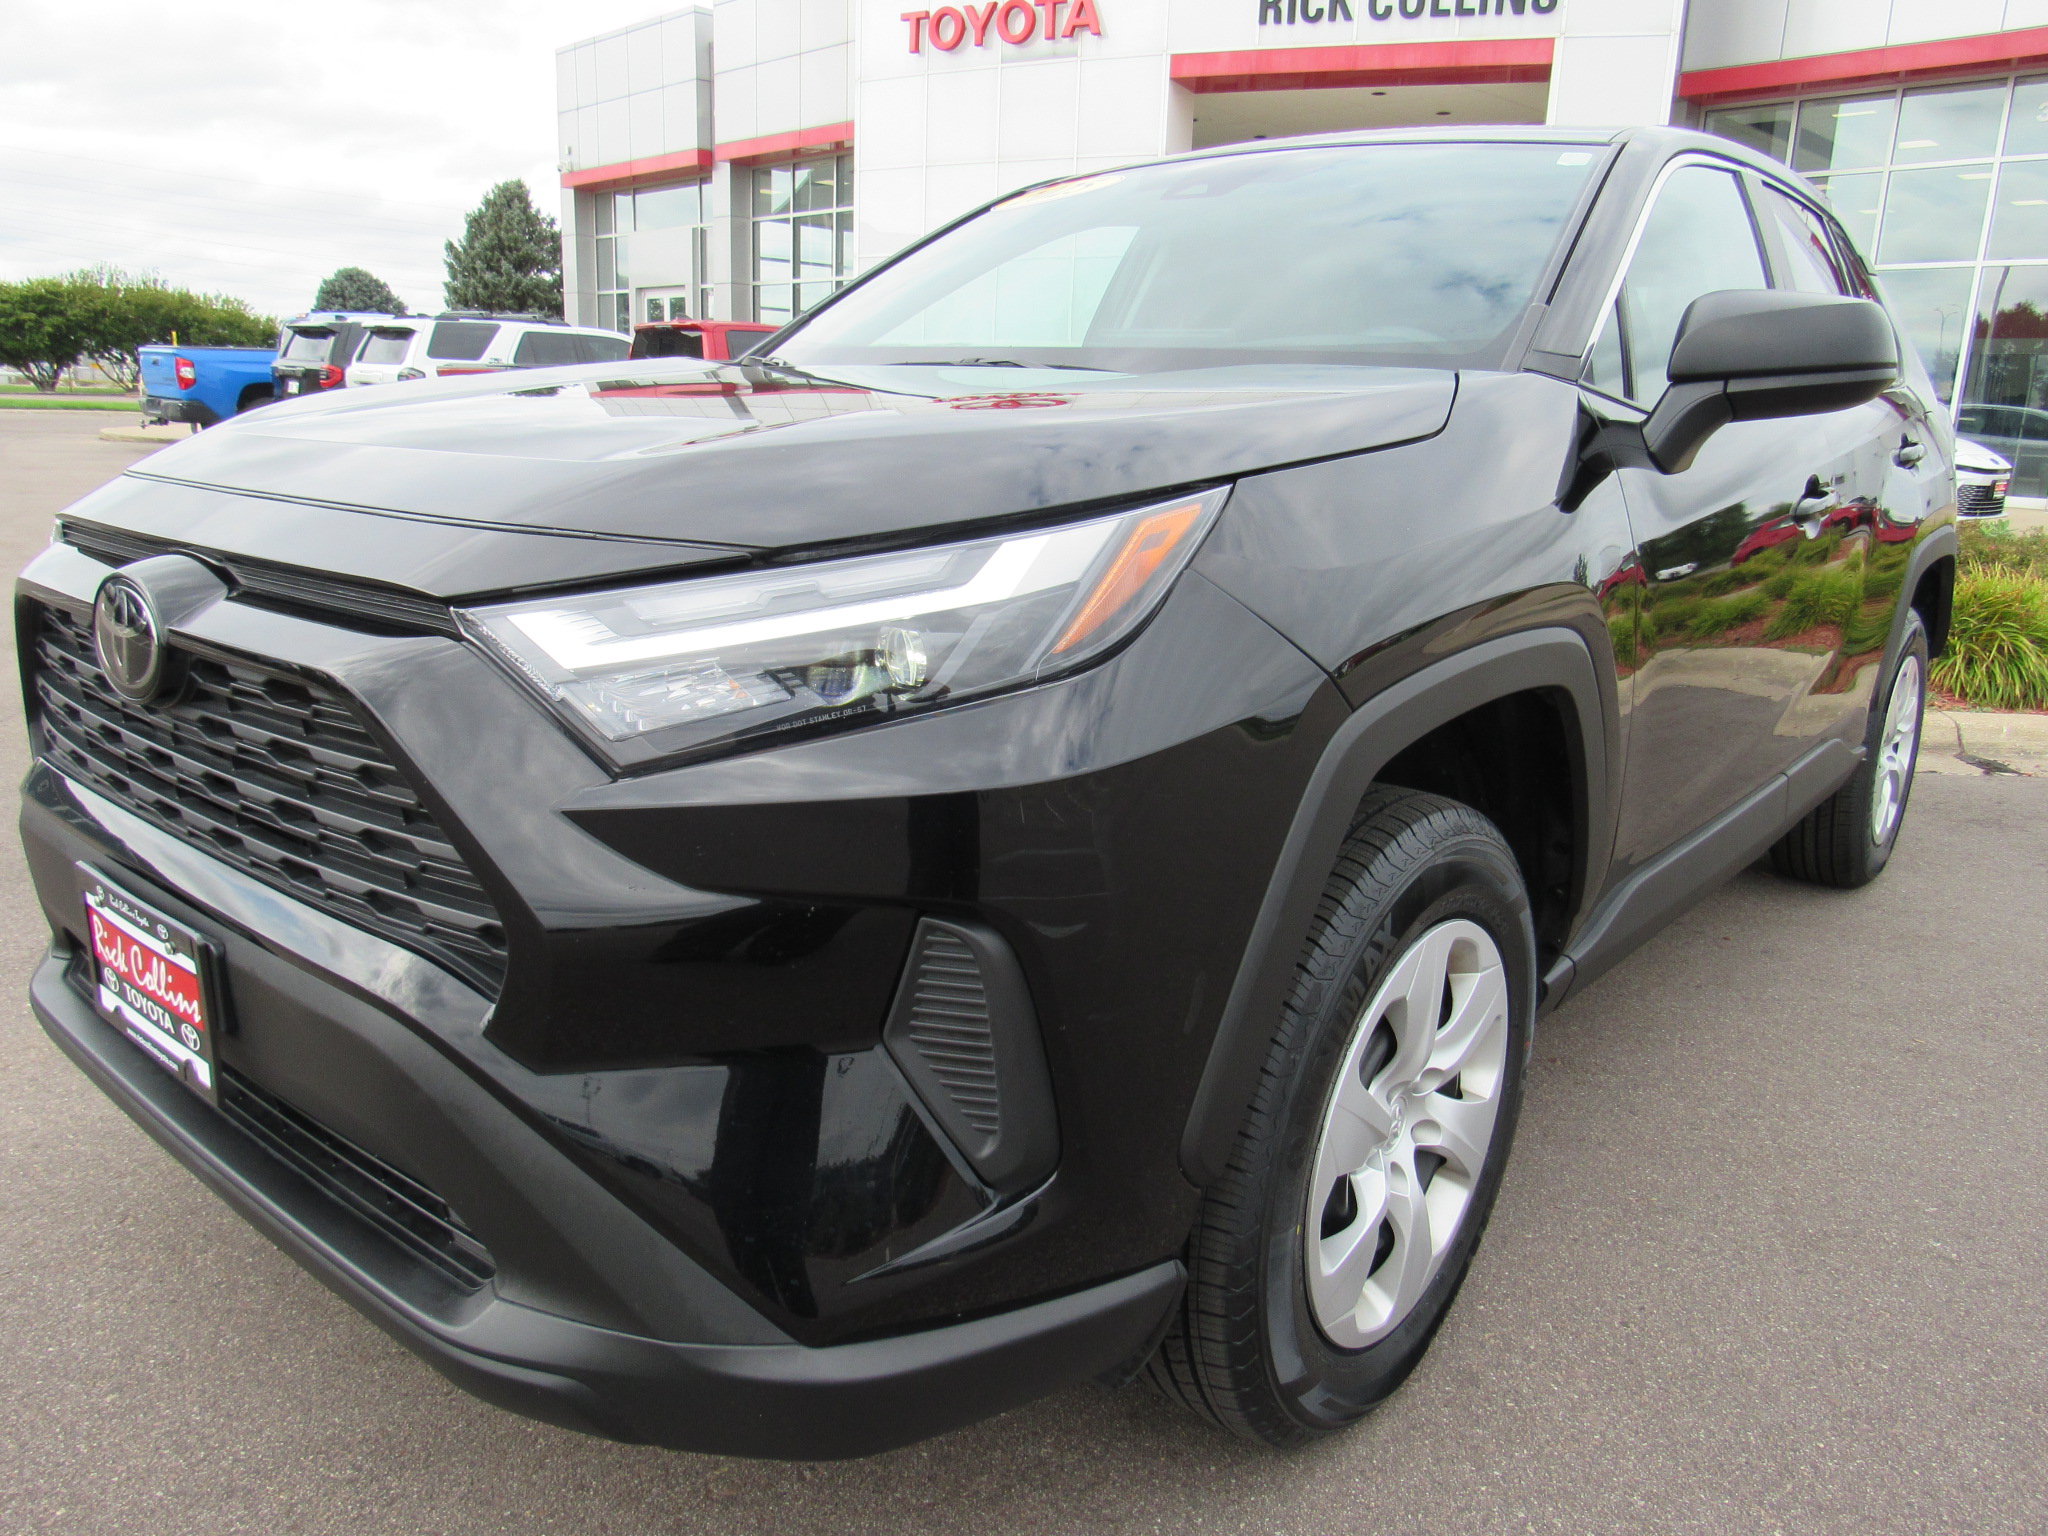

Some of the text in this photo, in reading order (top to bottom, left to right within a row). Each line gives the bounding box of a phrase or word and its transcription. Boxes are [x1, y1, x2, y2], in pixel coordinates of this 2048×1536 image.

[900, 0, 1102, 54] TOYOTA
[809, 710, 841, 724] STANLEY
[93, 914, 202, 1023] Rick Collins
[123, 982, 175, 1034] TOYOTA
